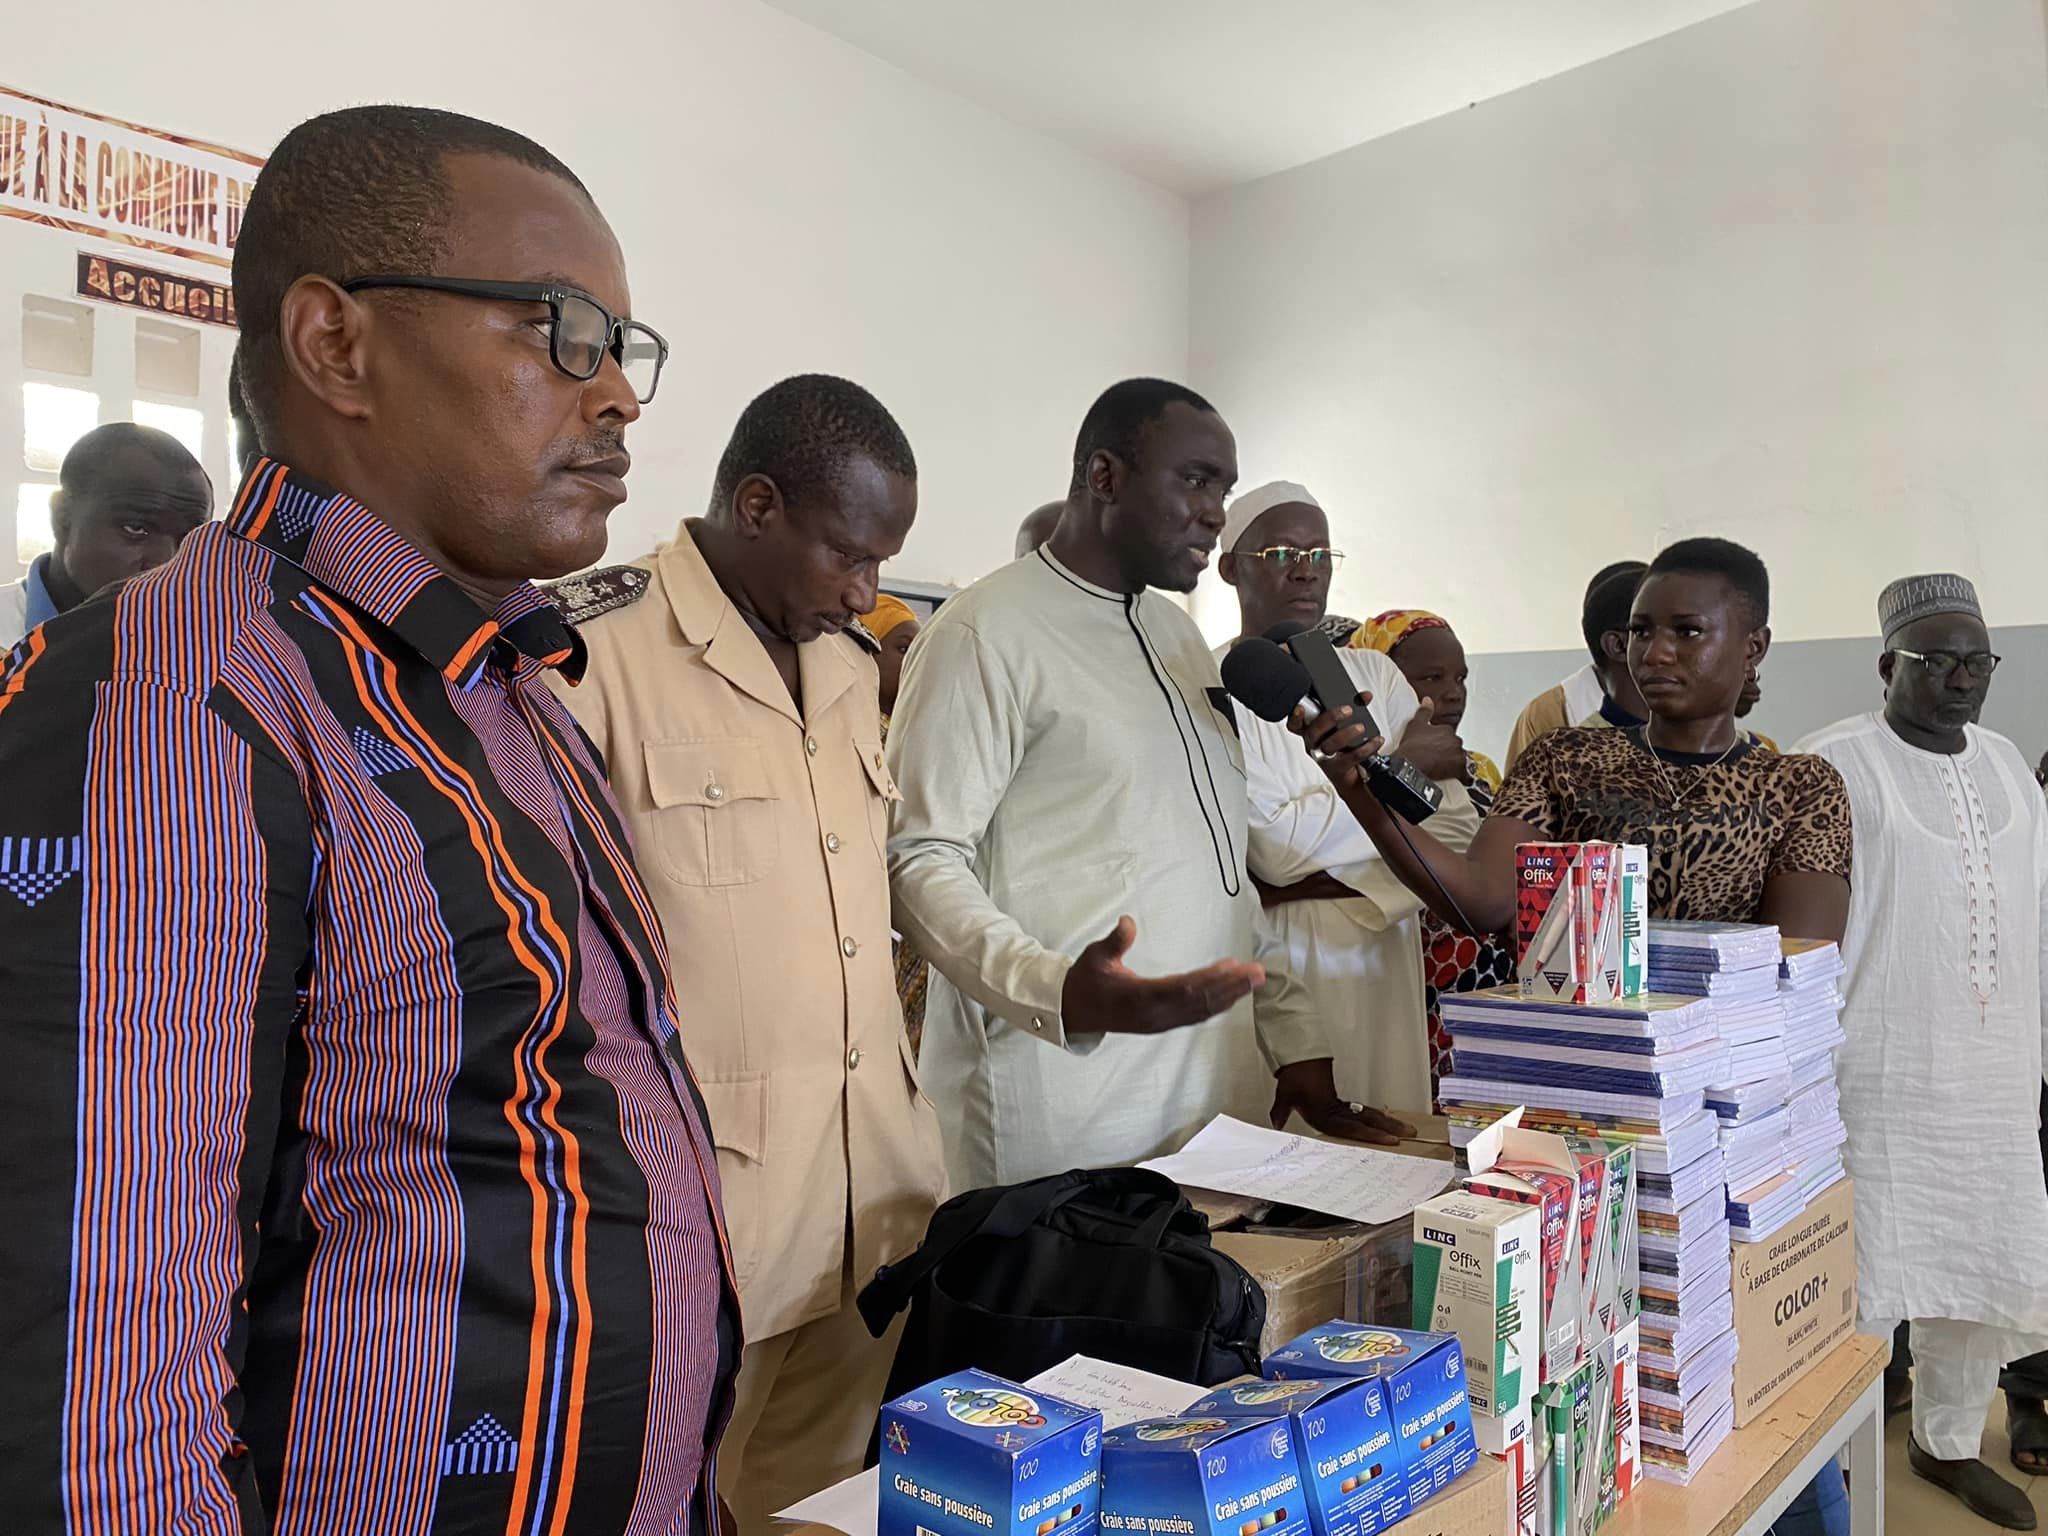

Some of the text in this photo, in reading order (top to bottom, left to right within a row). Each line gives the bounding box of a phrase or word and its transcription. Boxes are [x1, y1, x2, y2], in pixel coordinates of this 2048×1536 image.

[34, 110, 50, 203] À
[58, 130, 89, 214] LA
[97, 141, 219, 246] COMMUNE
[87, 257, 237, 325] Accueil
[1527, 857, 1551, 866] LINC
[1523, 869, 1554, 882] Offix
[1581, 1180, 1595, 1193] LINC
[1548, 1201, 1562, 1214] LINC
[1580, 1196, 1597, 1213] Offix
[1426, 1229, 1455, 1245] LINC
[1547, 1217, 1564, 1237] Offix
[1769, 1213, 1831, 1261] CRAIE LONGUE DURÉE
[1503, 1238, 1519, 1254] LINC
[1515, 1250, 1531, 1265] Offix
[1748, 1220, 1849, 1294] À BASE DE CARBONATE DE CALCIUM
[1449, 1250, 1481, 1270] Offix
[1395, 1382, 1411, 1404] 100
[1401, 1390, 1465, 1438] Craie sans poussière
[1498, 1401, 1506, 1413] 50
[1308, 1417, 1326, 1440] 100
[1317, 1430, 1391, 1478] Craie sans poussière
[1019, 1458, 1039, 1483] 100
[1206, 1456, 1227, 1479] 100
[894, 1474, 993, 1529] Craie sans poussière
[1018, 1470, 1097, 1521] Craie sans poussière
[1215, 1473, 1298, 1521] Craie sans poussière
[1100, 1511, 1194, 1536] Craie sans poussière
